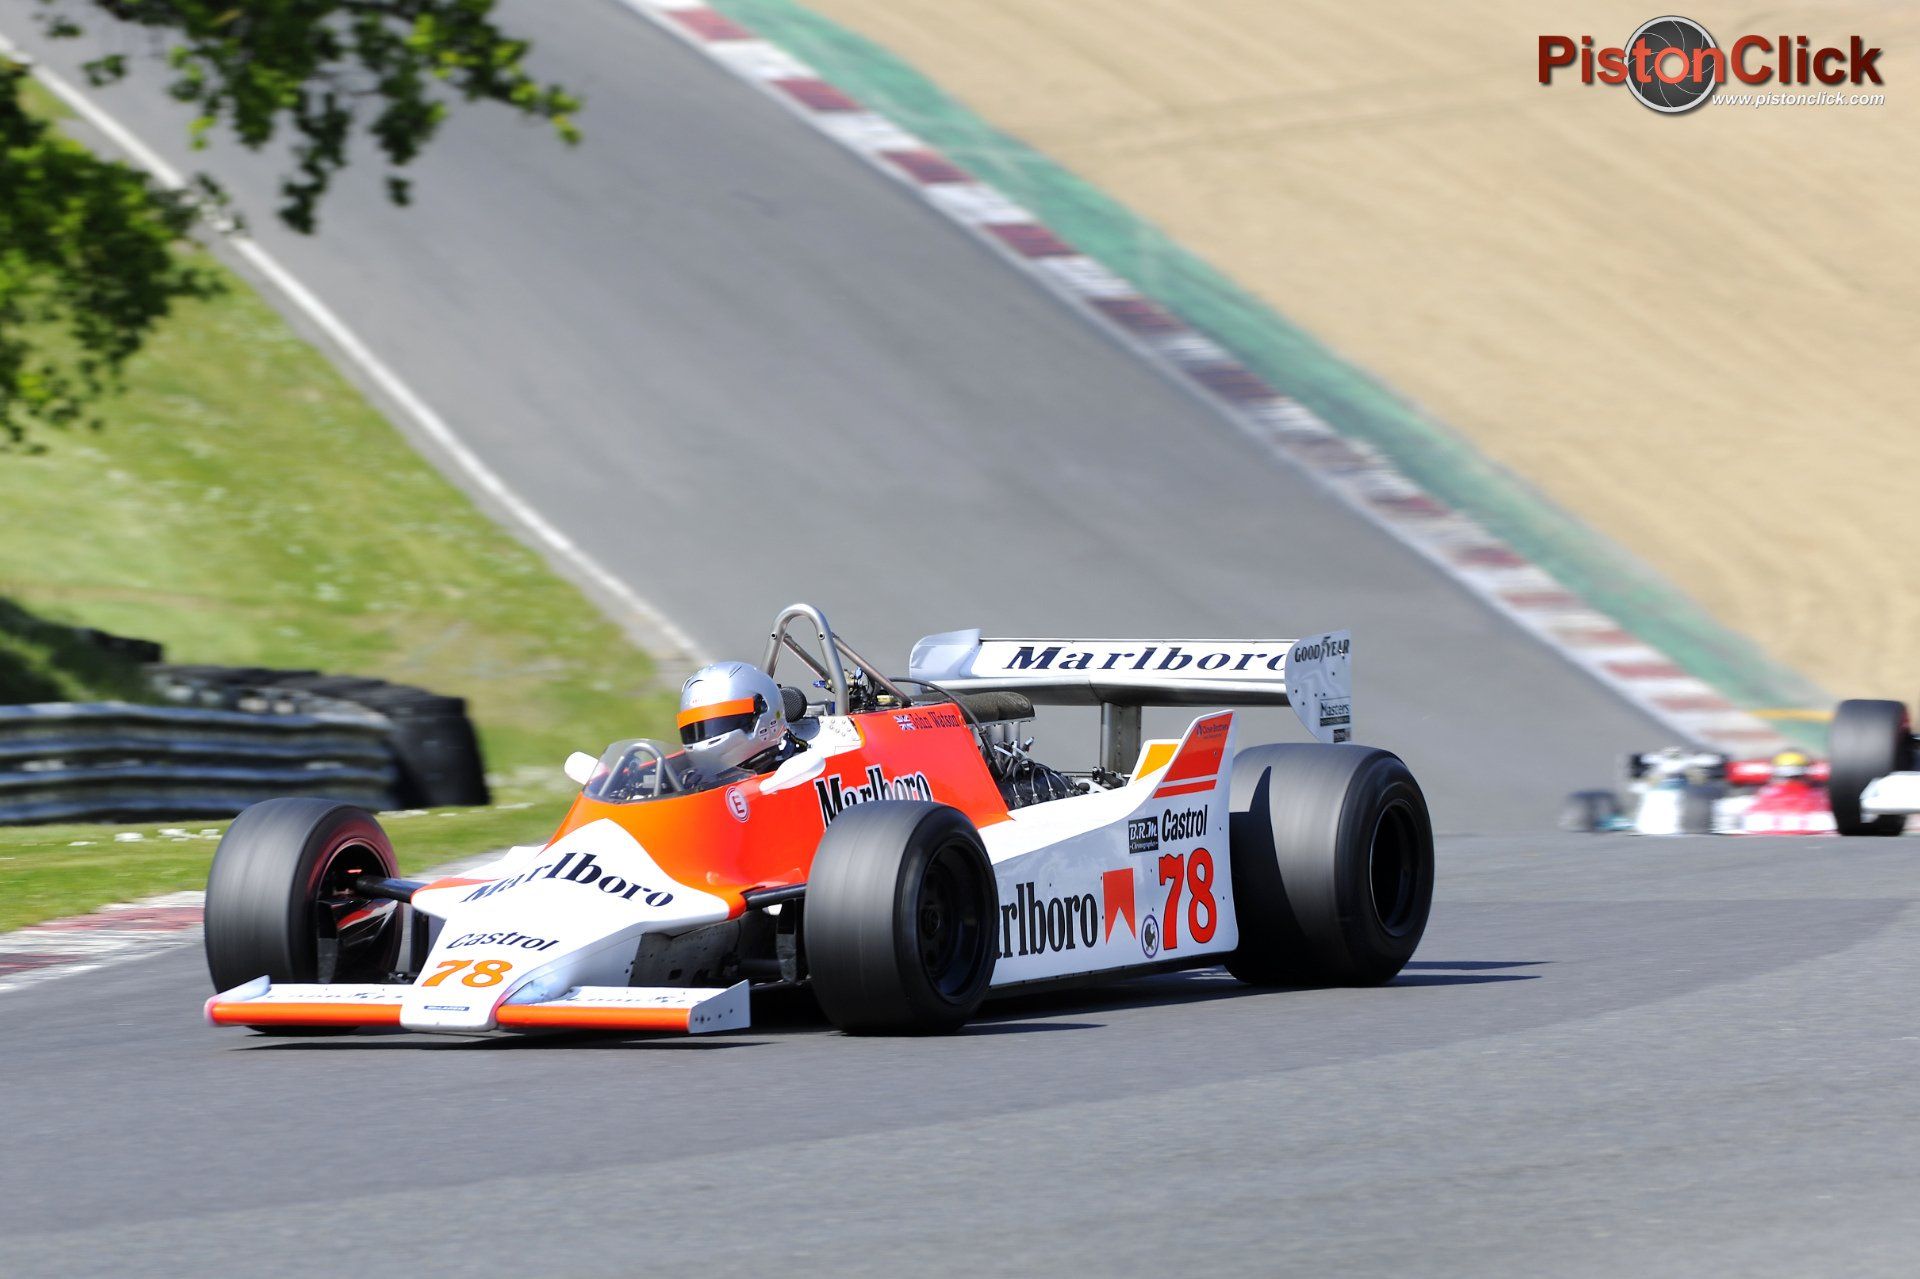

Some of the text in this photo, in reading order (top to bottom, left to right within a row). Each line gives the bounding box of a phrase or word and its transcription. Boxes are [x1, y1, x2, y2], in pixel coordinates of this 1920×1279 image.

[908, 711, 960, 730] John Watson
[1162, 804, 1208, 842] Castrol
[459, 852, 675, 907] Marlboro
[1158, 847, 1217, 951] 78
[991, 881, 1098, 960] rlboro
[421, 959, 513, 988] 78
